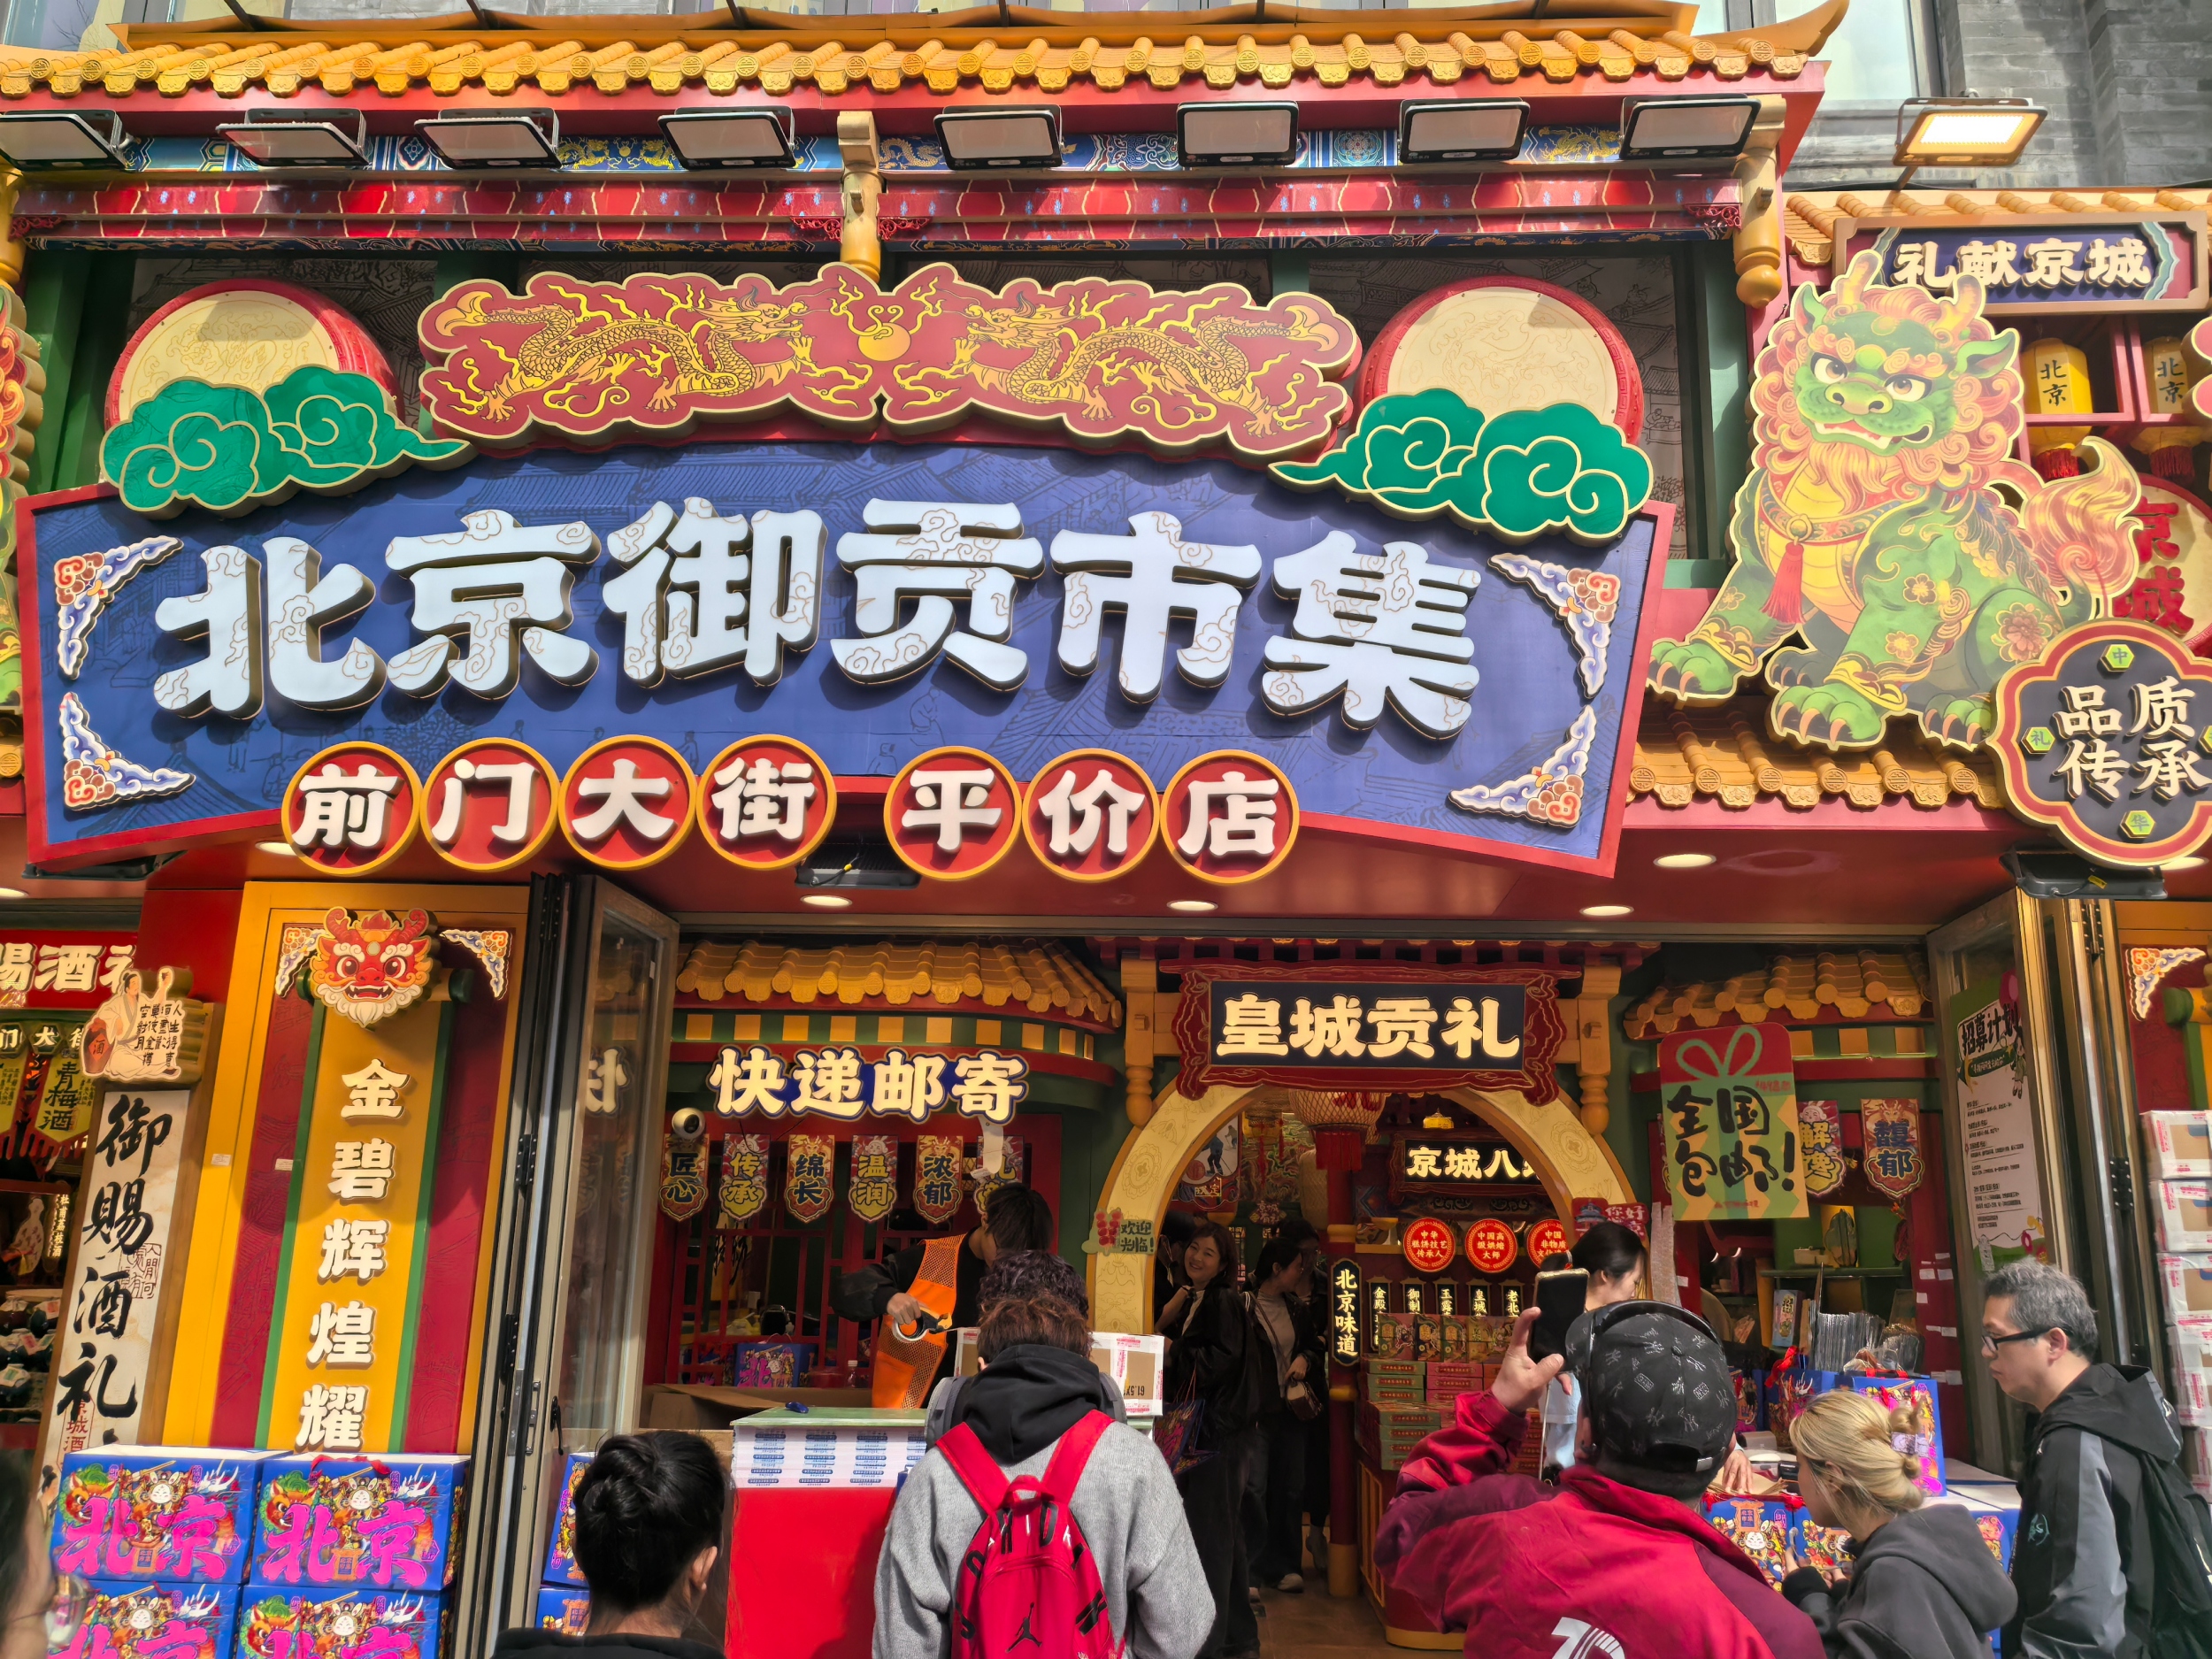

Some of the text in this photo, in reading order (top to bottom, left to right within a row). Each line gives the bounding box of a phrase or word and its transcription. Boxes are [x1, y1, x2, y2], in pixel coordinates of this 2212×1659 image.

[1893, 238, 2152, 288] 礼献京城
[2039, 357, 2068, 406] 北京
[2155, 356, 2185, 405] 北京
[153, 496, 1483, 736] 北京御贡市集
[2112, 648, 2129, 664] 中
[2053, 675, 2196, 740] 品质
[2030, 729, 2052, 747] 礼
[2053, 738, 2211, 802] 传承
[291, 757, 1279, 860] 前门大街 平价店
[2131, 814, 2150, 833] 华
[1216, 992, 1521, 1059] 皇城贡礼
[1961, 1002, 2022, 1056] 招募计划
[38, 1061, 81, 1132] 青梅酒
[709, 1046, 1024, 1121] 快递邮寄
[1667, 1085, 1770, 1141] 全国
[1874, 1118, 1914, 1179] 馥郁
[667, 1152, 699, 1203] 匠心
[726, 1152, 761, 1204] 传承
[794, 1153, 826, 1206] 绵长
[856, 1154, 890, 1207] 温润
[924, 1155, 956, 1207] 浓郁
[1120, 1220, 1152, 1235] 欢迎
[296, 1058, 410, 1451] 金碧辉煌耀
[1334, 1268, 1359, 1356] 北京味道
[1408, 1287, 1420, 1314] 御制
[1440, 1288, 1454, 1316] 玉露
[1474, 1289, 1487, 1317] 皇城
[1507, 1289, 1520, 1317] 老北
[58, 1494, 227, 1579] 北京
[262, 1500, 427, 1586] 北京
